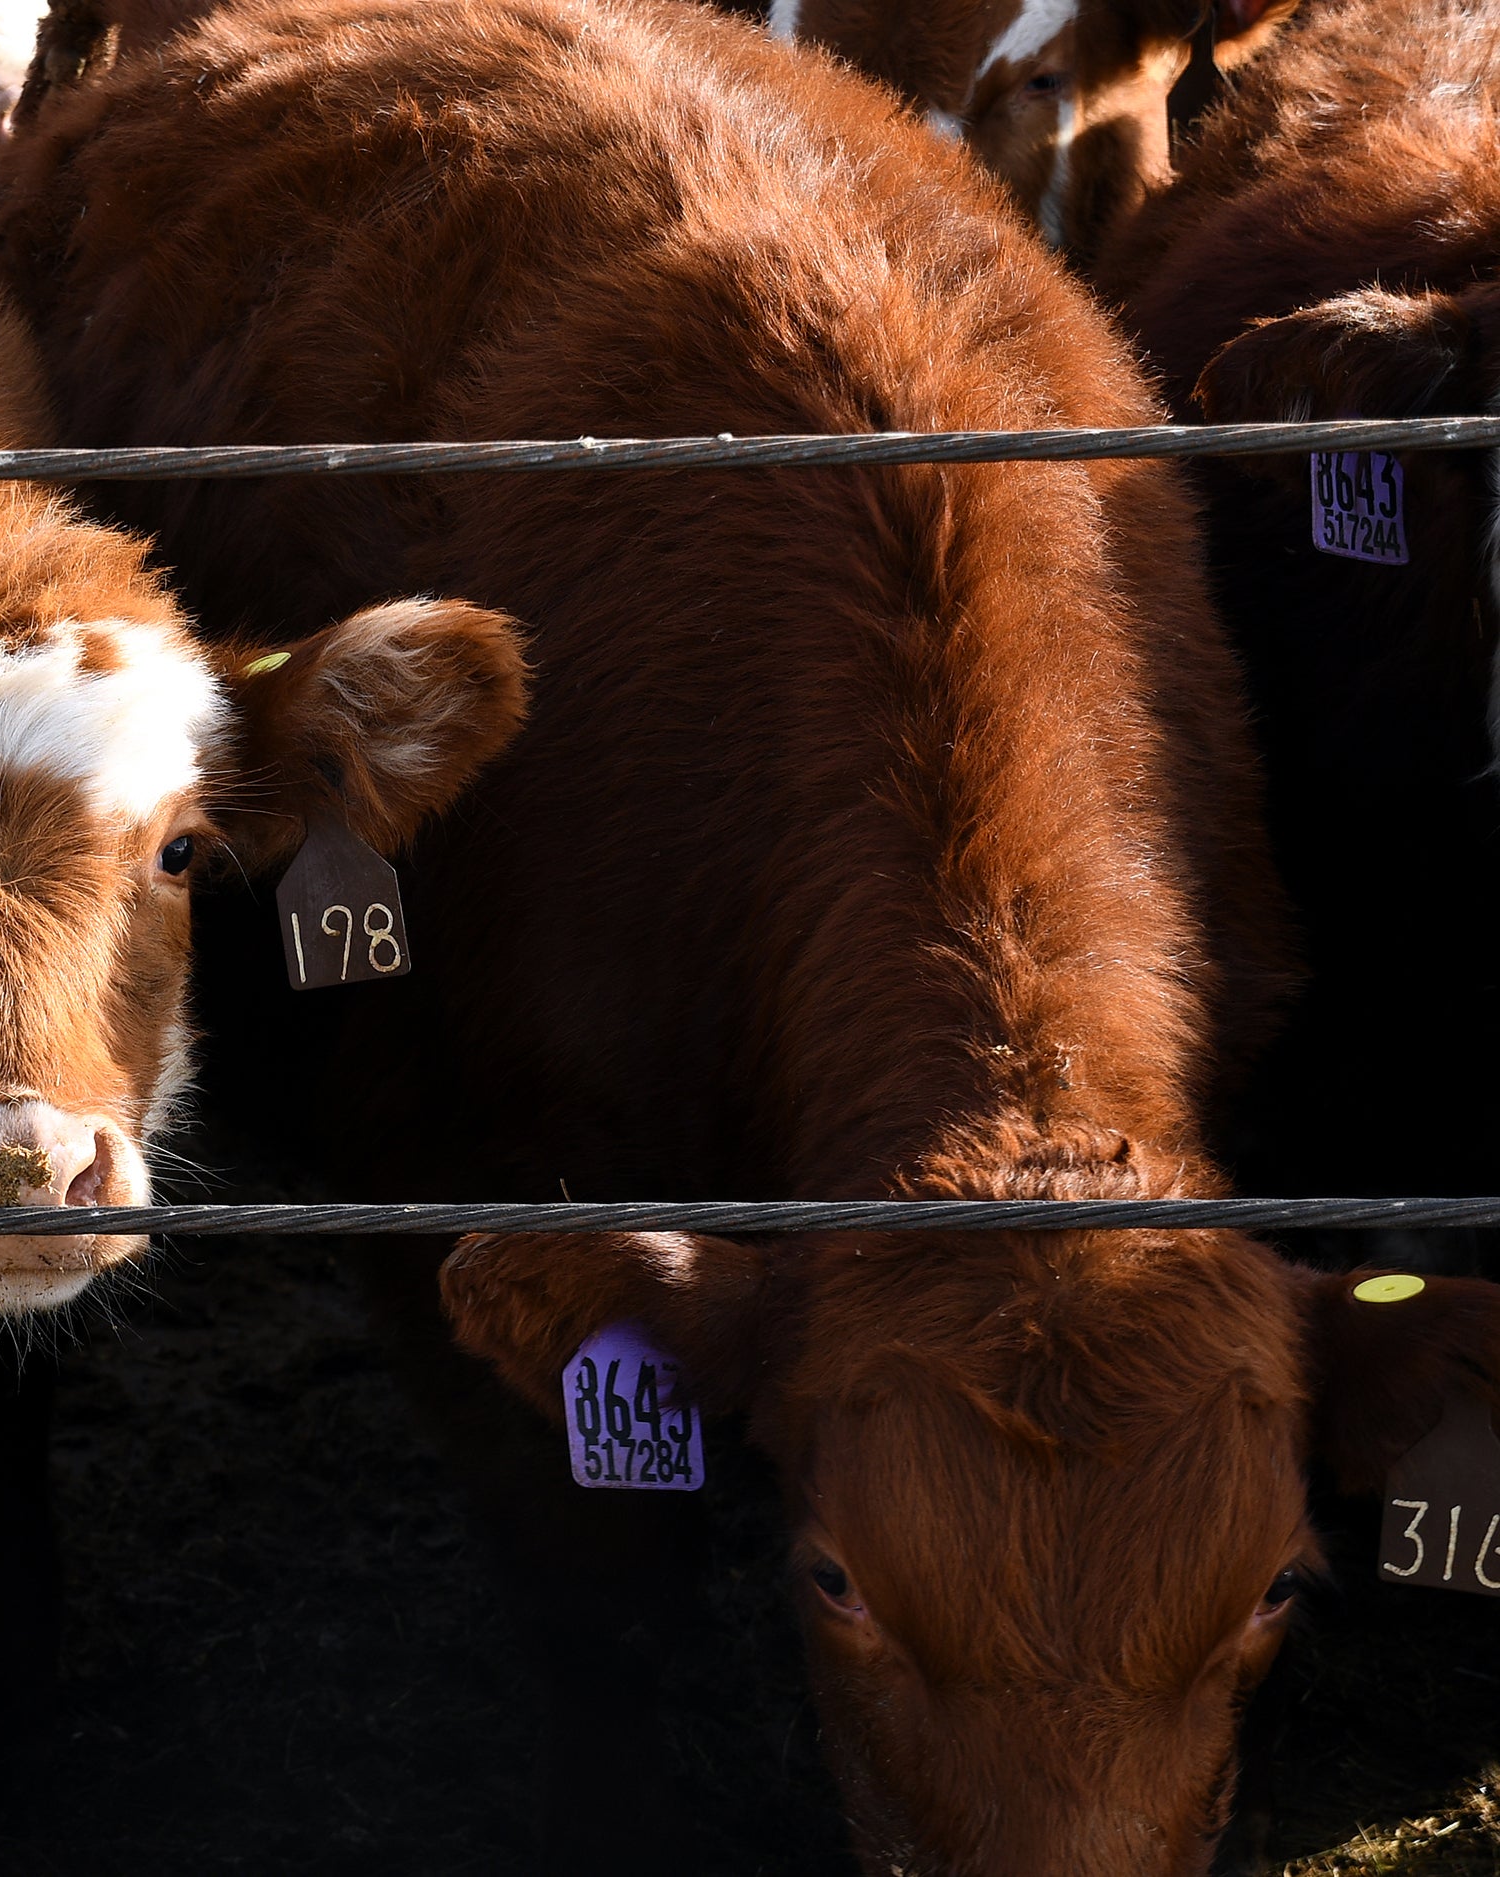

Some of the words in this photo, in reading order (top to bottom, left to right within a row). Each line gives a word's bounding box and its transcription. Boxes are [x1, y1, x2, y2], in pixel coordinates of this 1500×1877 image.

[1318, 451, 1397, 519] 8643
[1323, 508, 1401, 558] 517244
[291, 903, 401, 983] 198
[585, 1436, 693, 1483] 517284
